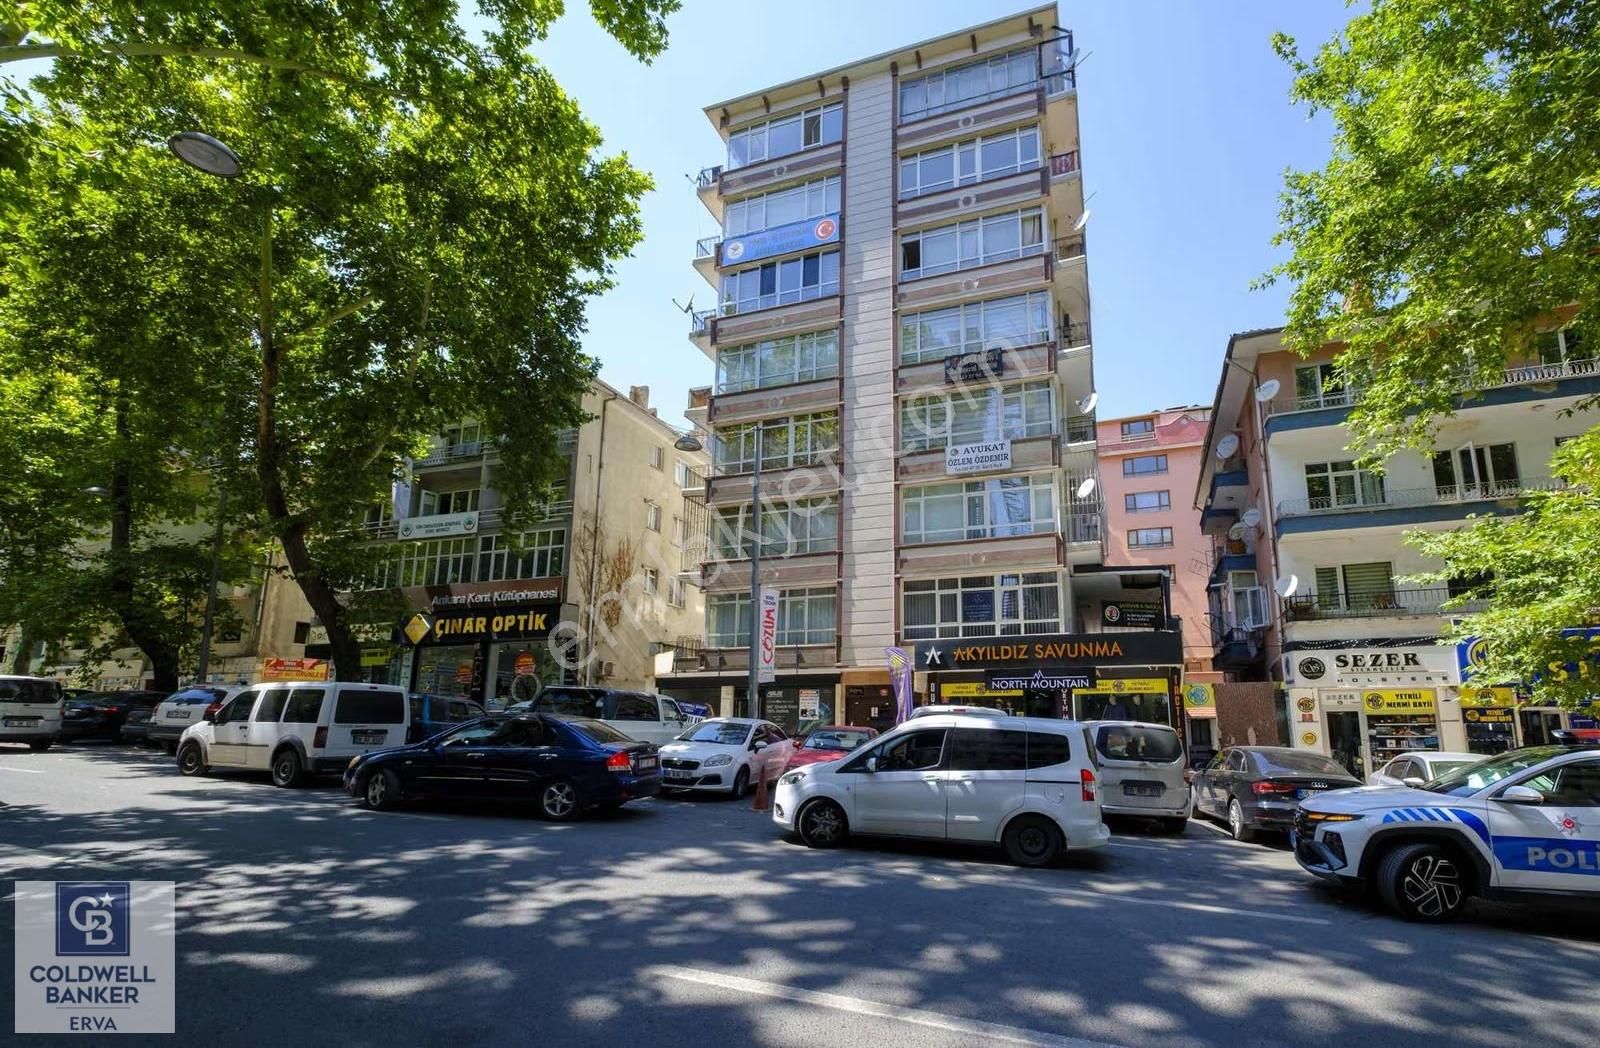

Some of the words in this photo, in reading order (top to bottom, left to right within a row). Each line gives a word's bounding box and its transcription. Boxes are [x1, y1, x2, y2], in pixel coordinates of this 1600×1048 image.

[963, 443, 1006, 454] AVUKAT
[432, 595, 467, 606] Ankara
[467, 592, 491, 605] Kent
[493, 587, 558, 604] Kütüphanesi
[435, 617, 487, 638] ÇINAR
[492, 610, 548, 633] OPTİK
[953, 644, 1029, 661] AKYILDIZ
[1034, 640, 1124, 659] SAVUNMA
[1335, 653, 1421, 668] SEZER
[992, 679, 1028, 689] NORTH
[1030, 678, 1089, 689] MOUNTAIN
